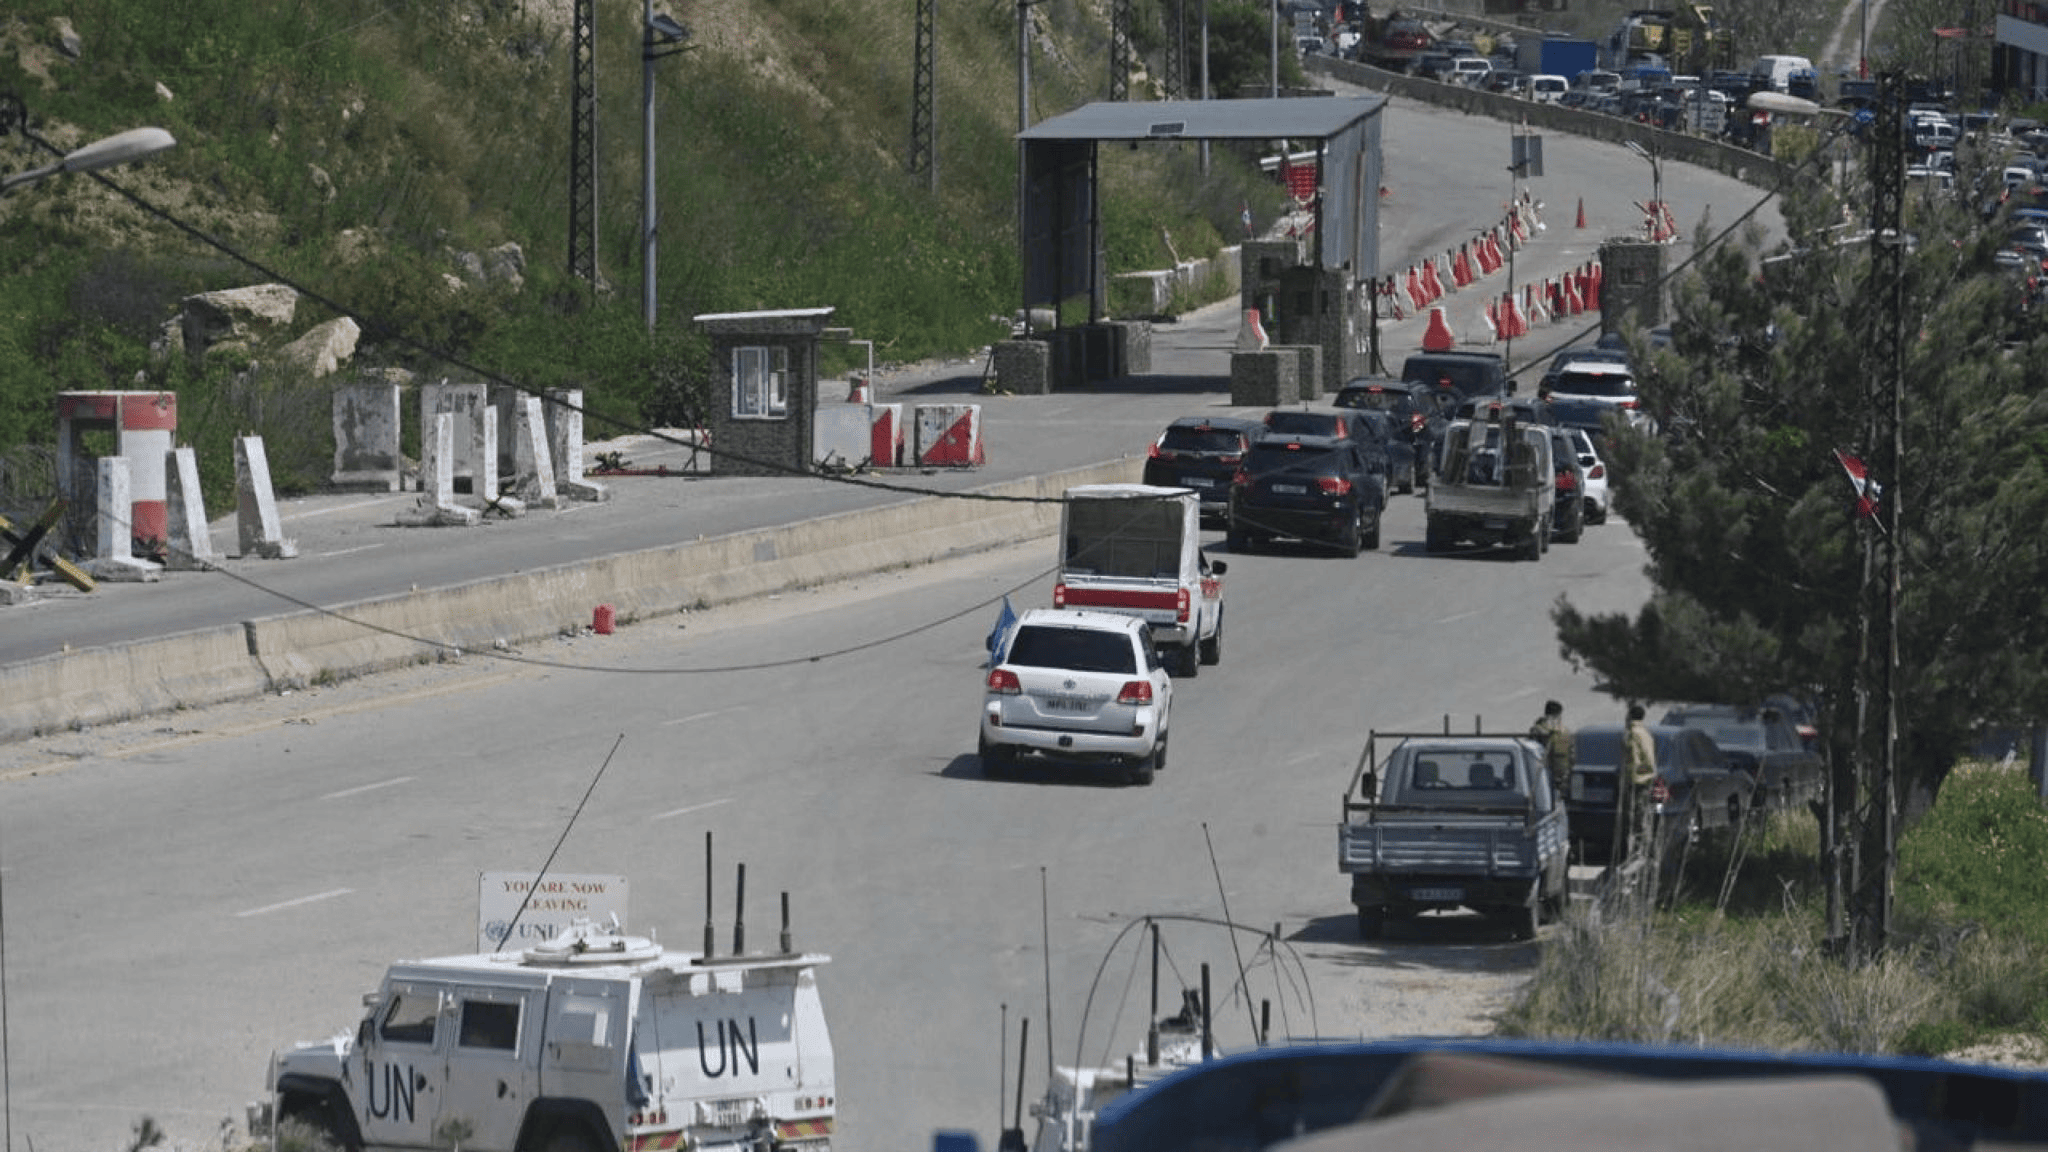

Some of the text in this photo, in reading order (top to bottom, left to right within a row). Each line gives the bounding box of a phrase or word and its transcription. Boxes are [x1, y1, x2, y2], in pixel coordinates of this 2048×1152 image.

[538, 881, 568, 893] ARE
[571, 882, 606, 894] NOW
[696, 1016, 759, 1078] UN
[368, 1062, 415, 1122] UN
